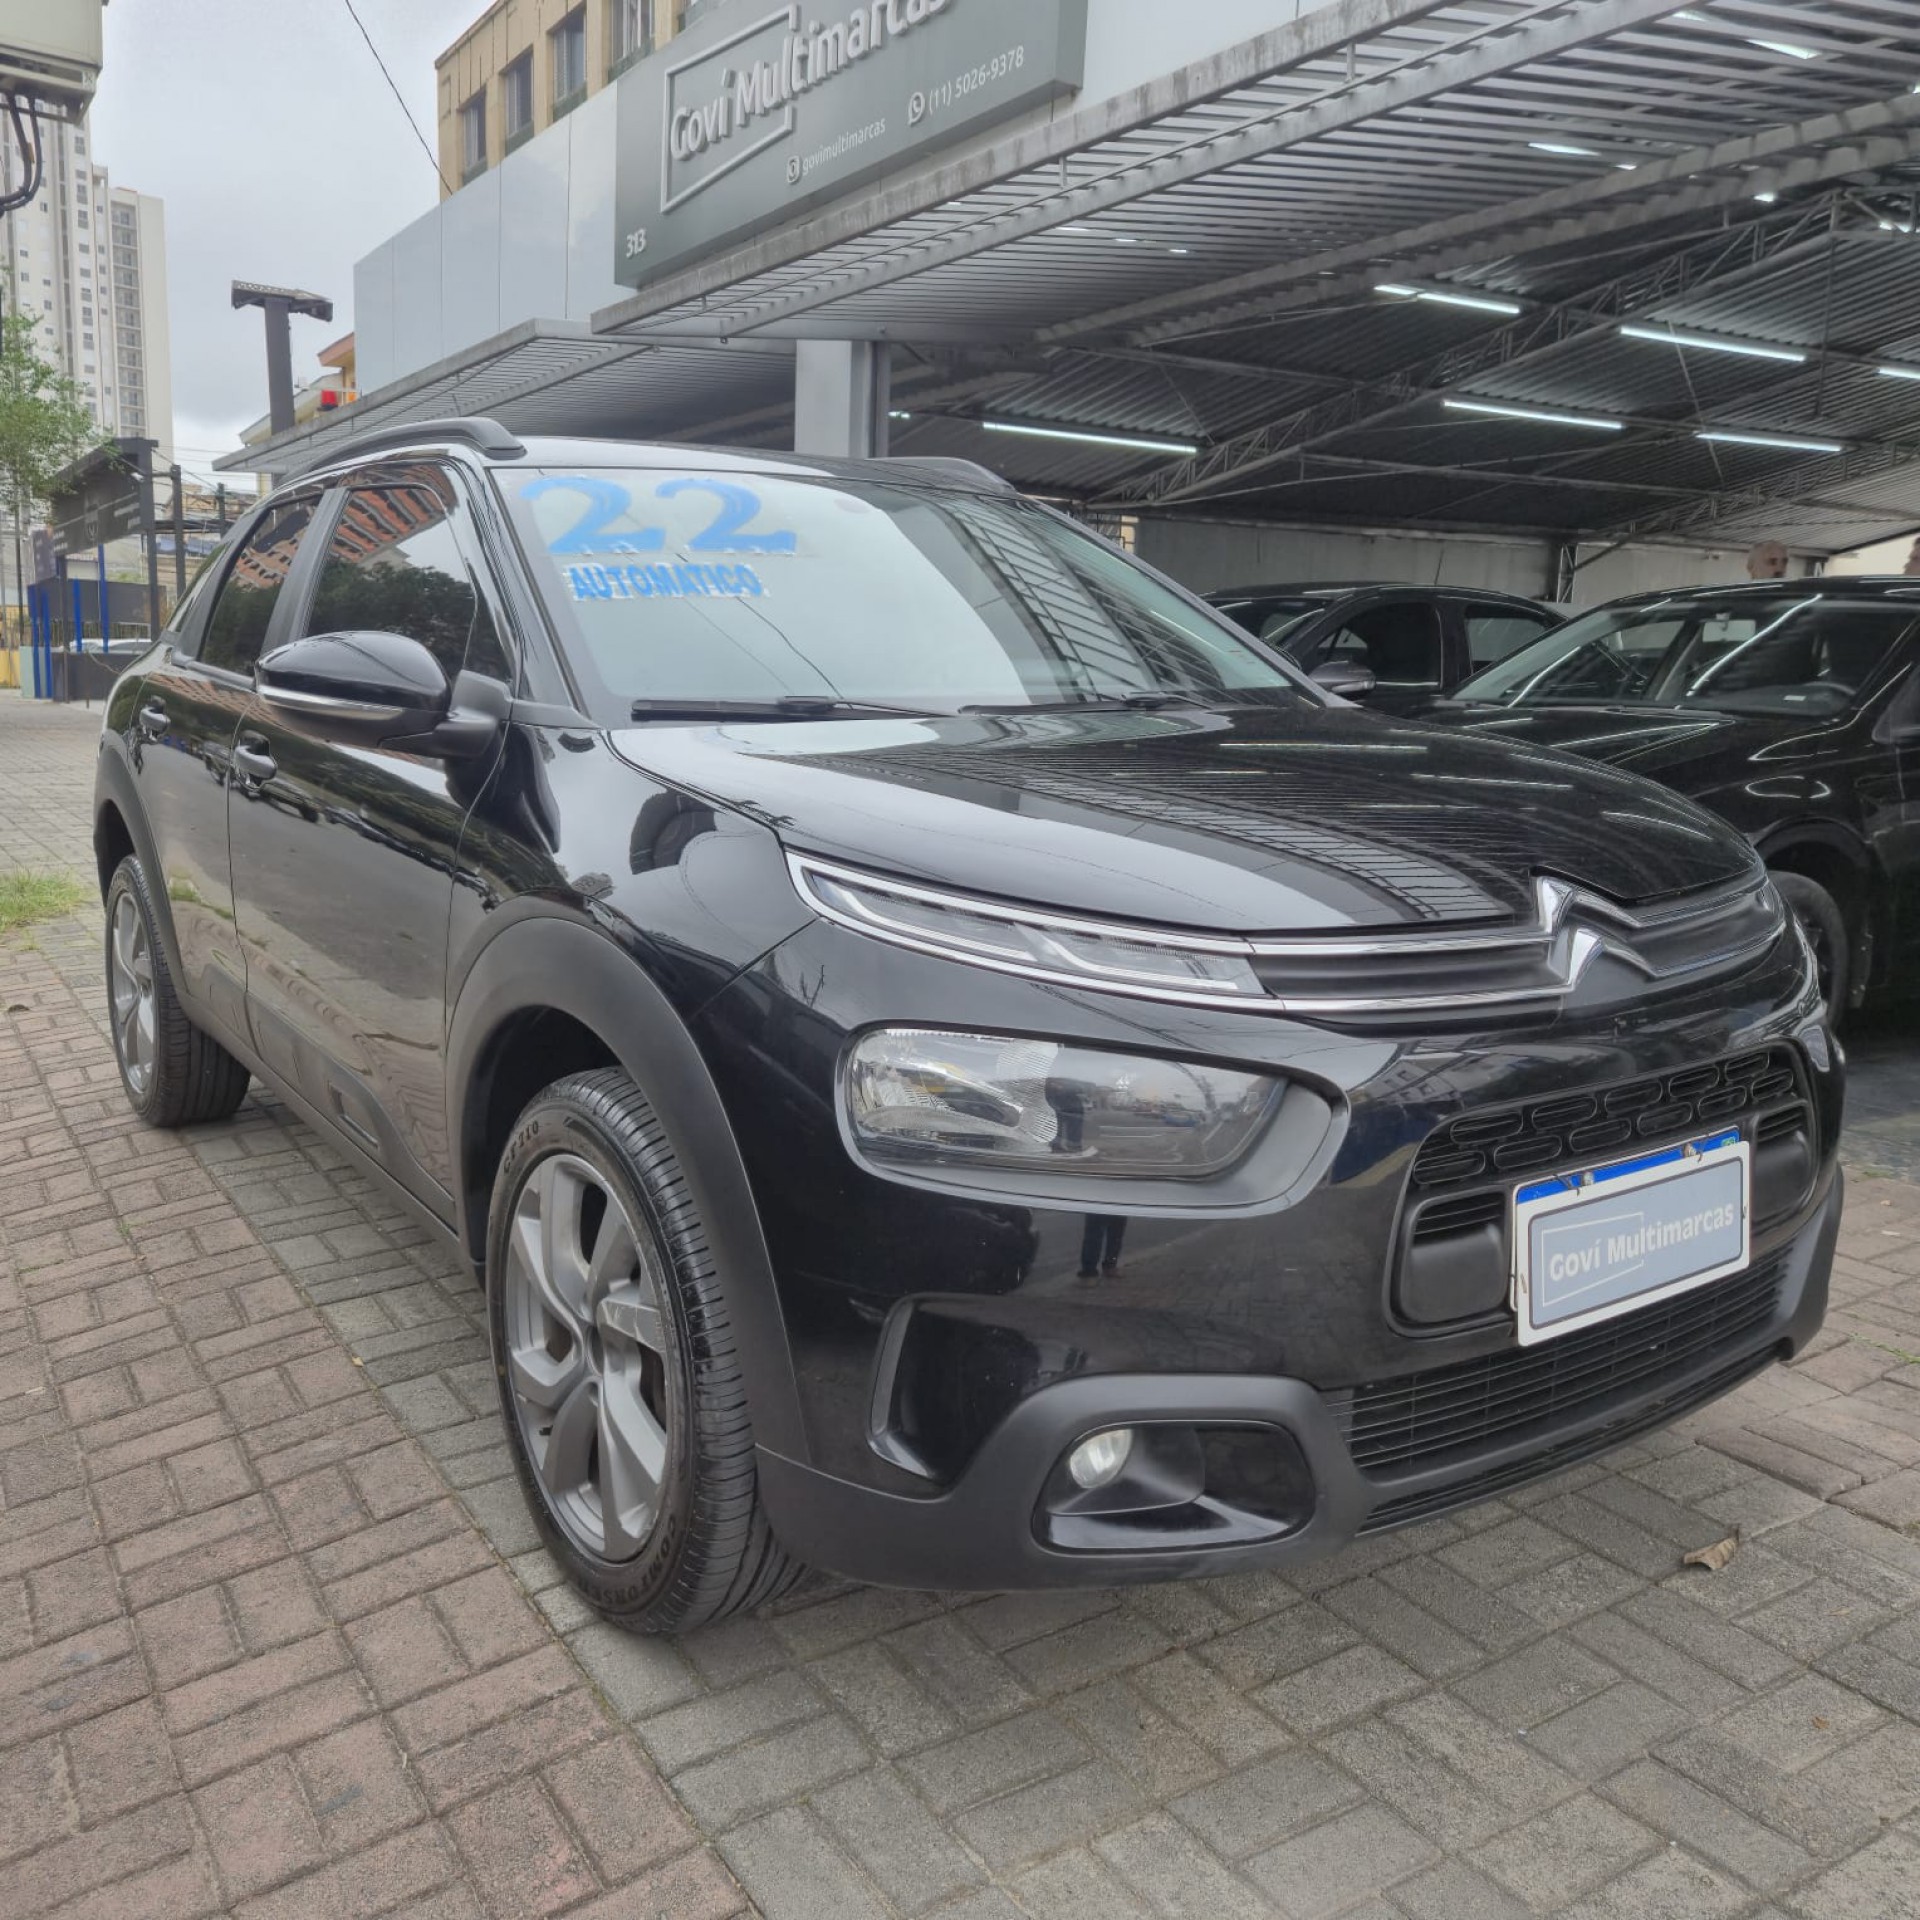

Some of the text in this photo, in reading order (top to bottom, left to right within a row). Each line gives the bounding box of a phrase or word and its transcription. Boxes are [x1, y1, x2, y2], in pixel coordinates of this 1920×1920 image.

[929, 45, 1024, 115] (11) 5026-9378
[802, 118, 886, 177] govimultimarcas
[519, 476, 797, 555] 22
[567, 563, 765, 600] AUTOMATICO
[1607, 1203, 1734, 1265] Multimarcas
